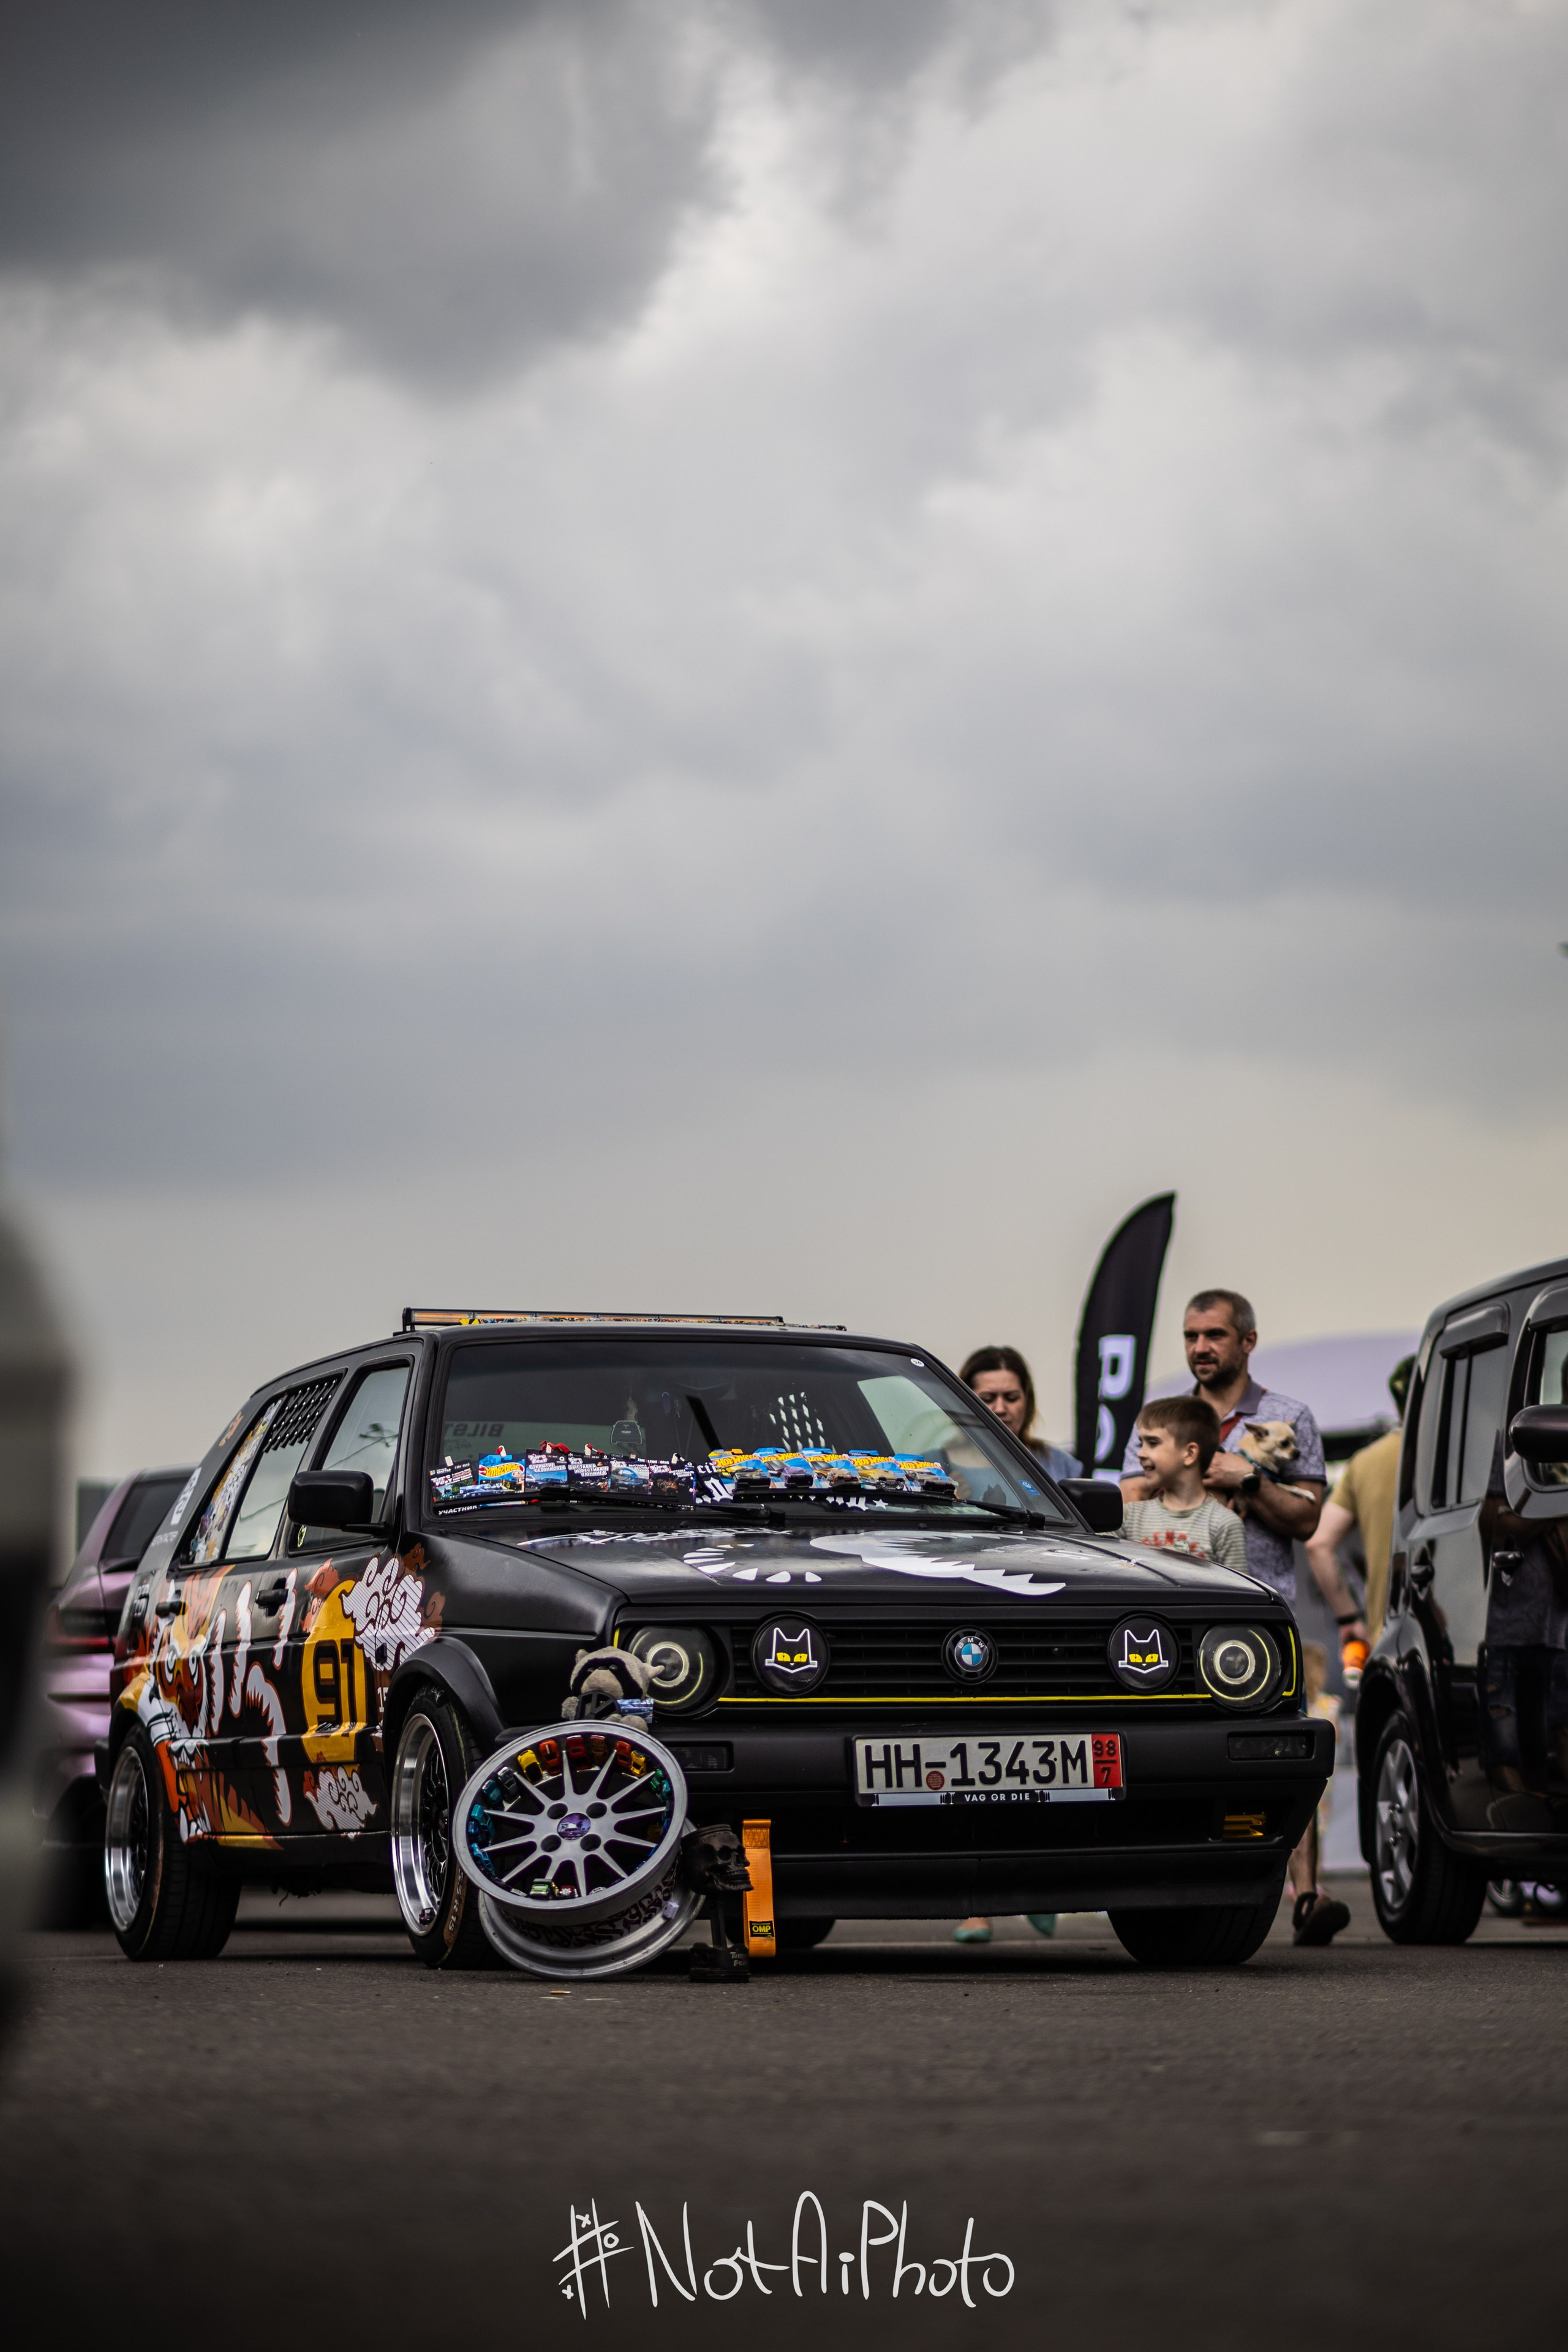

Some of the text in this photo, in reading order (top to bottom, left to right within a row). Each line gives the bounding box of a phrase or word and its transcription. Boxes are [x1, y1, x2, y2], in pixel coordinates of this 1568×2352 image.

[439, 1504, 478, 1515] УЧАСТНИК
[957, 1637, 984, 1649] BMW
[314, 1638, 358, 1735] 91
[1093, 1739, 1117, 1757] 98
[1101, 1766, 1111, 1784] 7
[991, 1793, 1006, 1801] OR
[1011, 1792, 1030, 1801] DIE
